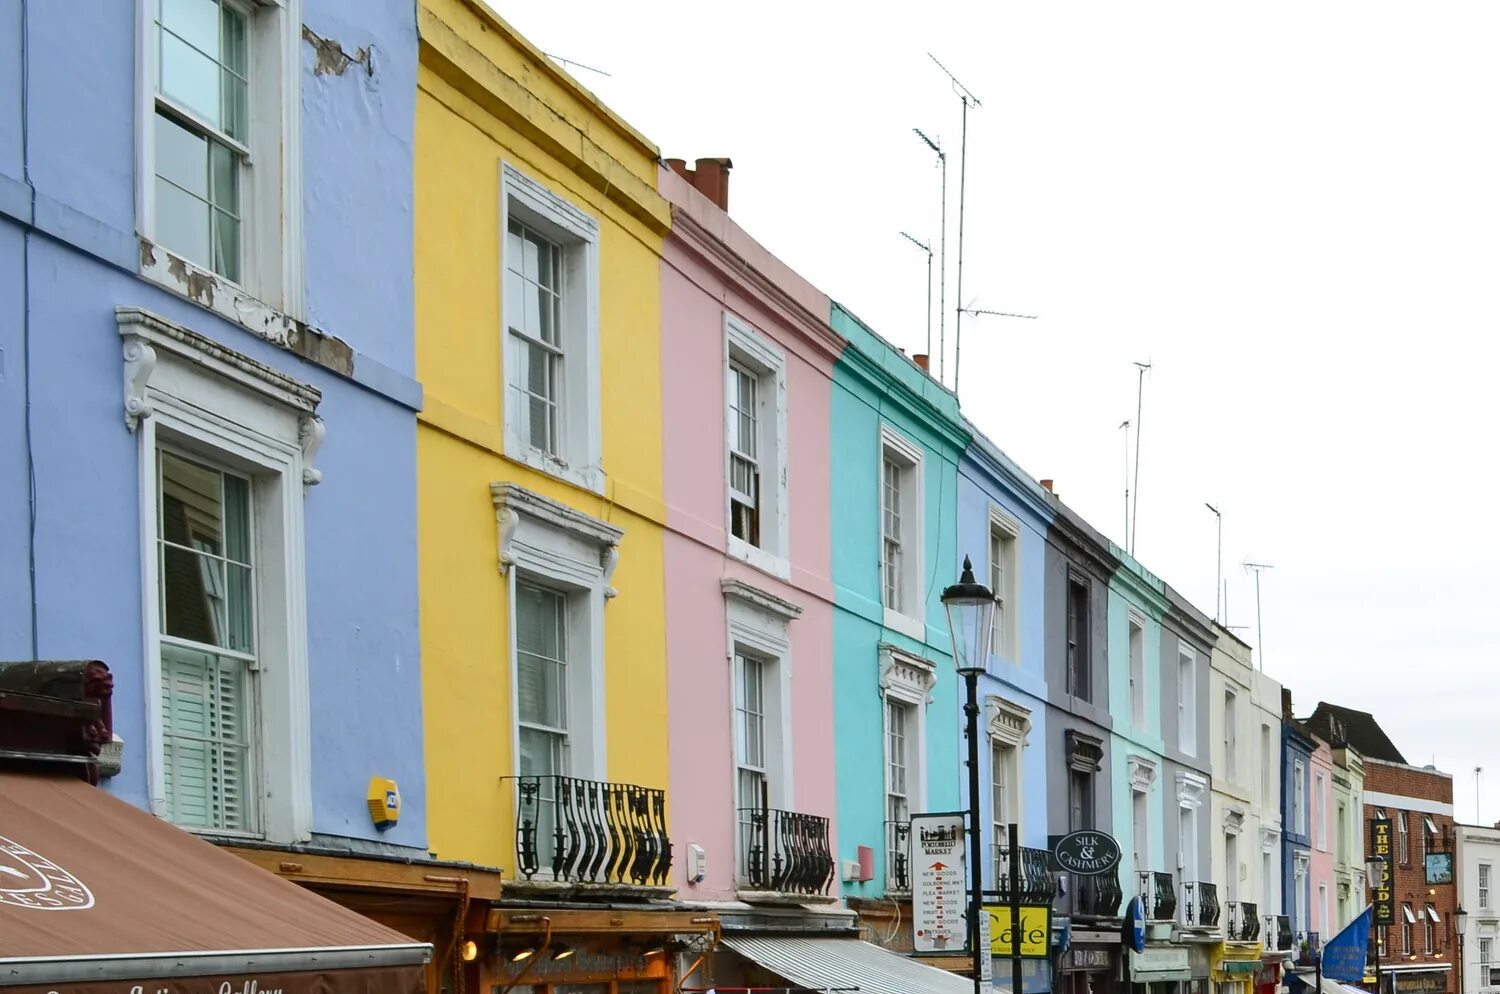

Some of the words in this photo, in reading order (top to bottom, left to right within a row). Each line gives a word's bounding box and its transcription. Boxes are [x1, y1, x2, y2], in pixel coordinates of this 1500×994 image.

[1075, 836, 1099, 846] SILK
[1376, 824, 1389, 855] THE
[1060, 851, 1116, 869] CASHMERE
[1080, 846, 1095, 859] &
